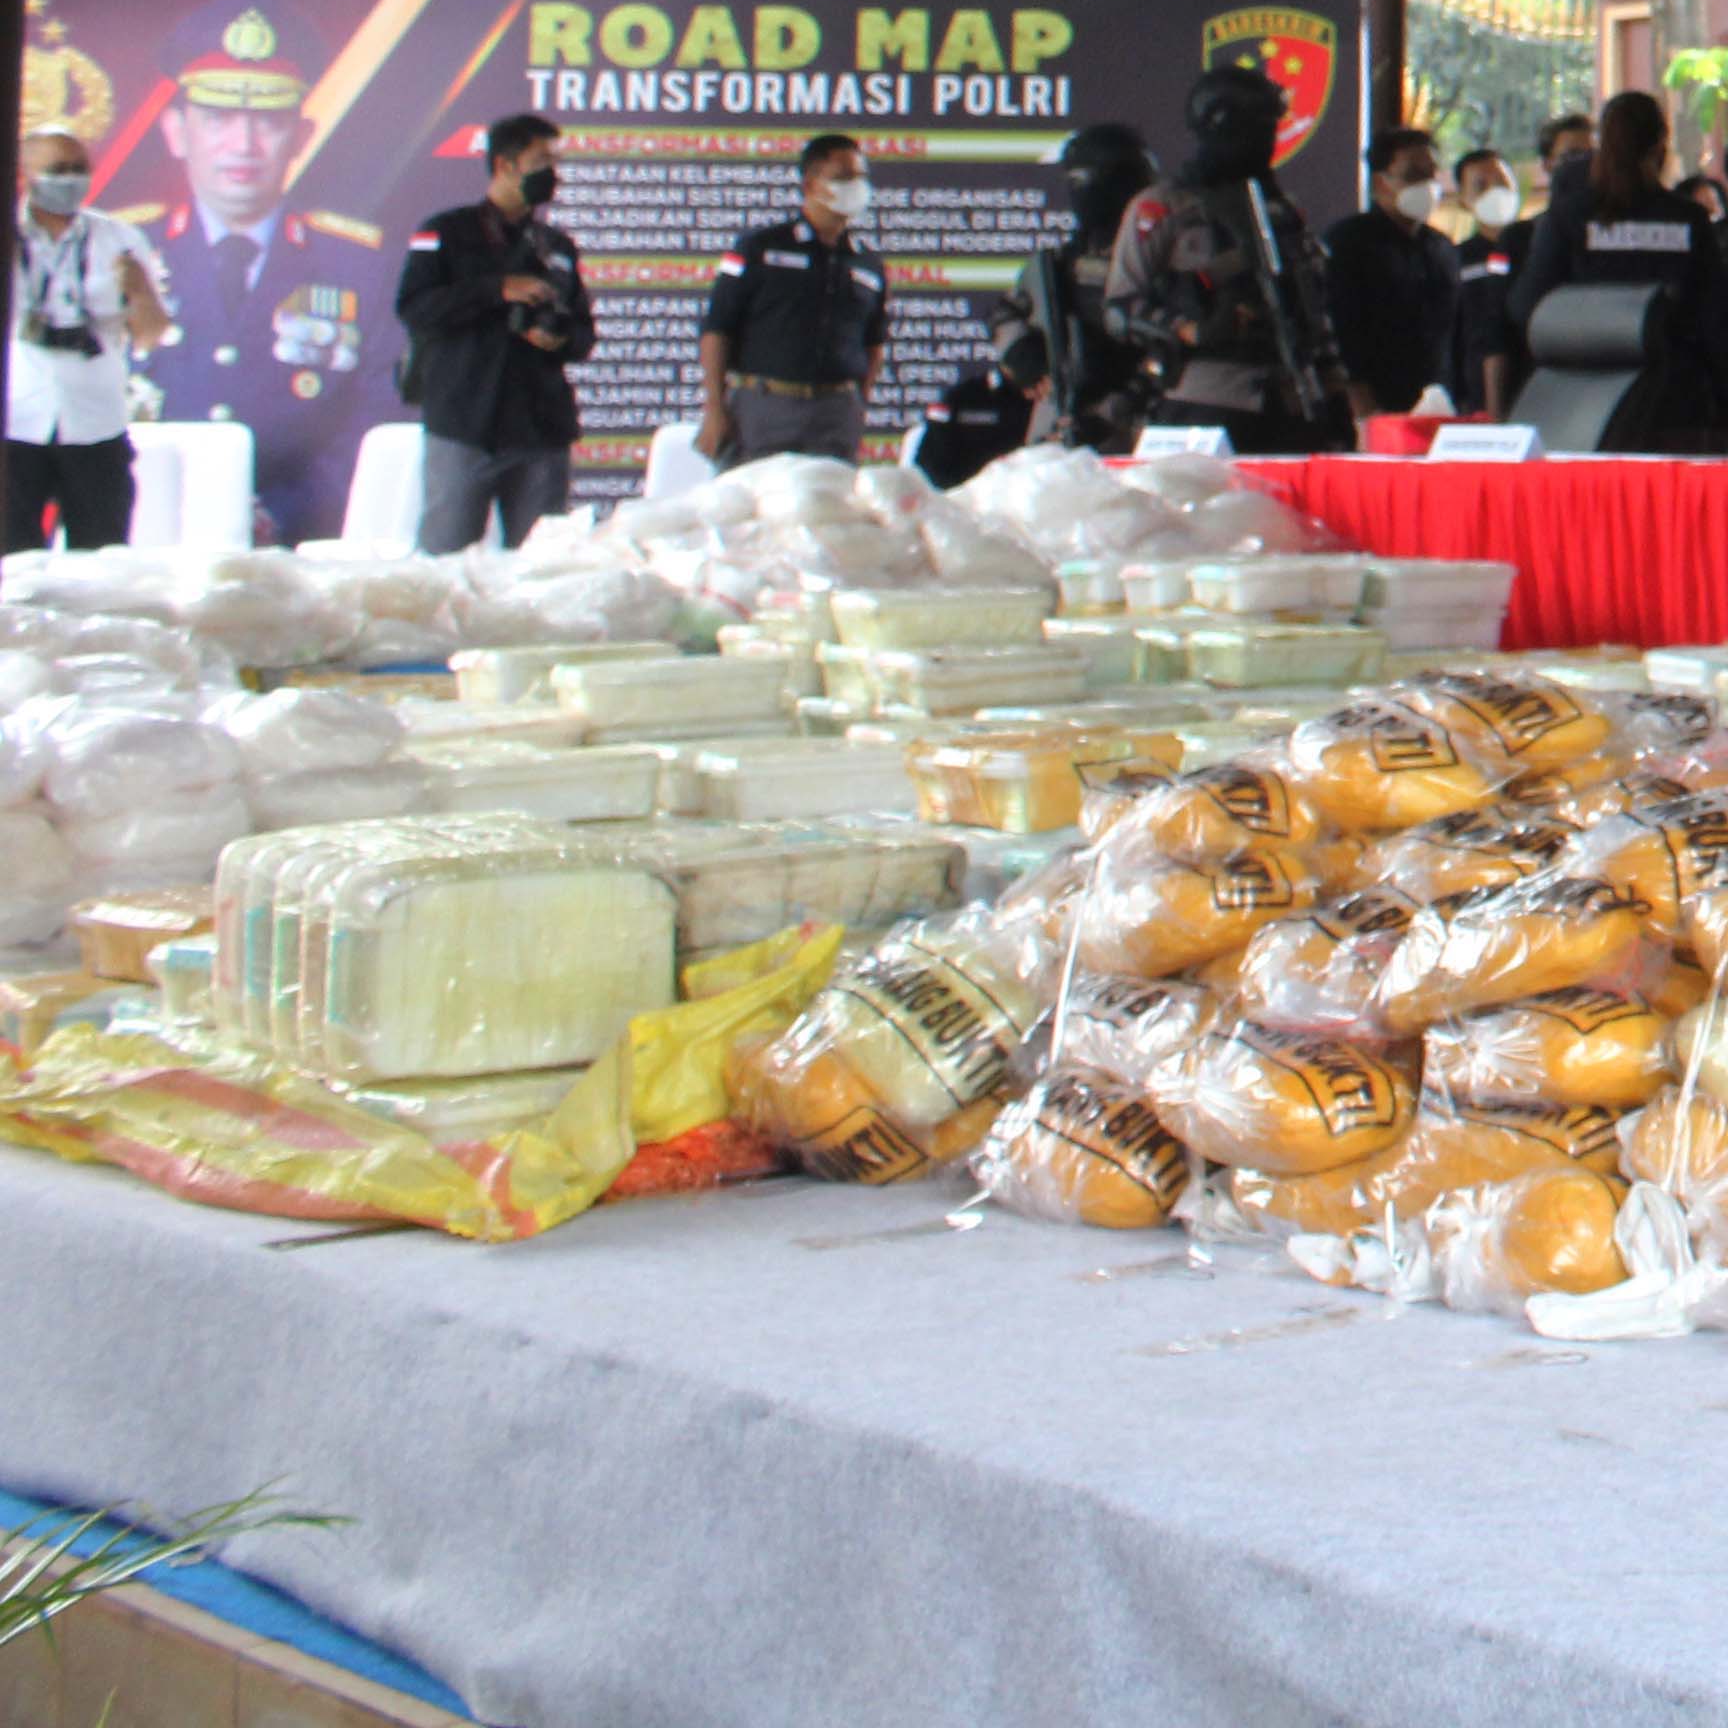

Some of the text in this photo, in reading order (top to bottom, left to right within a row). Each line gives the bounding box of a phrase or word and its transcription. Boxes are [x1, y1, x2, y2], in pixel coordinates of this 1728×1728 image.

[528, 1, 1074, 72] ROAD MAP
[526, 69, 1071, 116] TRANSFORMASI POLRI
[687, 187, 768, 208] SISTEM
[912, 190, 1045, 209] ORGANISASI
[549, 208, 693, 230] MENJADIKAN
[879, 212, 967, 233] UNGGUL
[971, 212, 993, 233] DI
[997, 212, 1040, 233] ERA
[942, 233, 1034, 253] MODERN
[894, 342, 970, 363] DALAM
